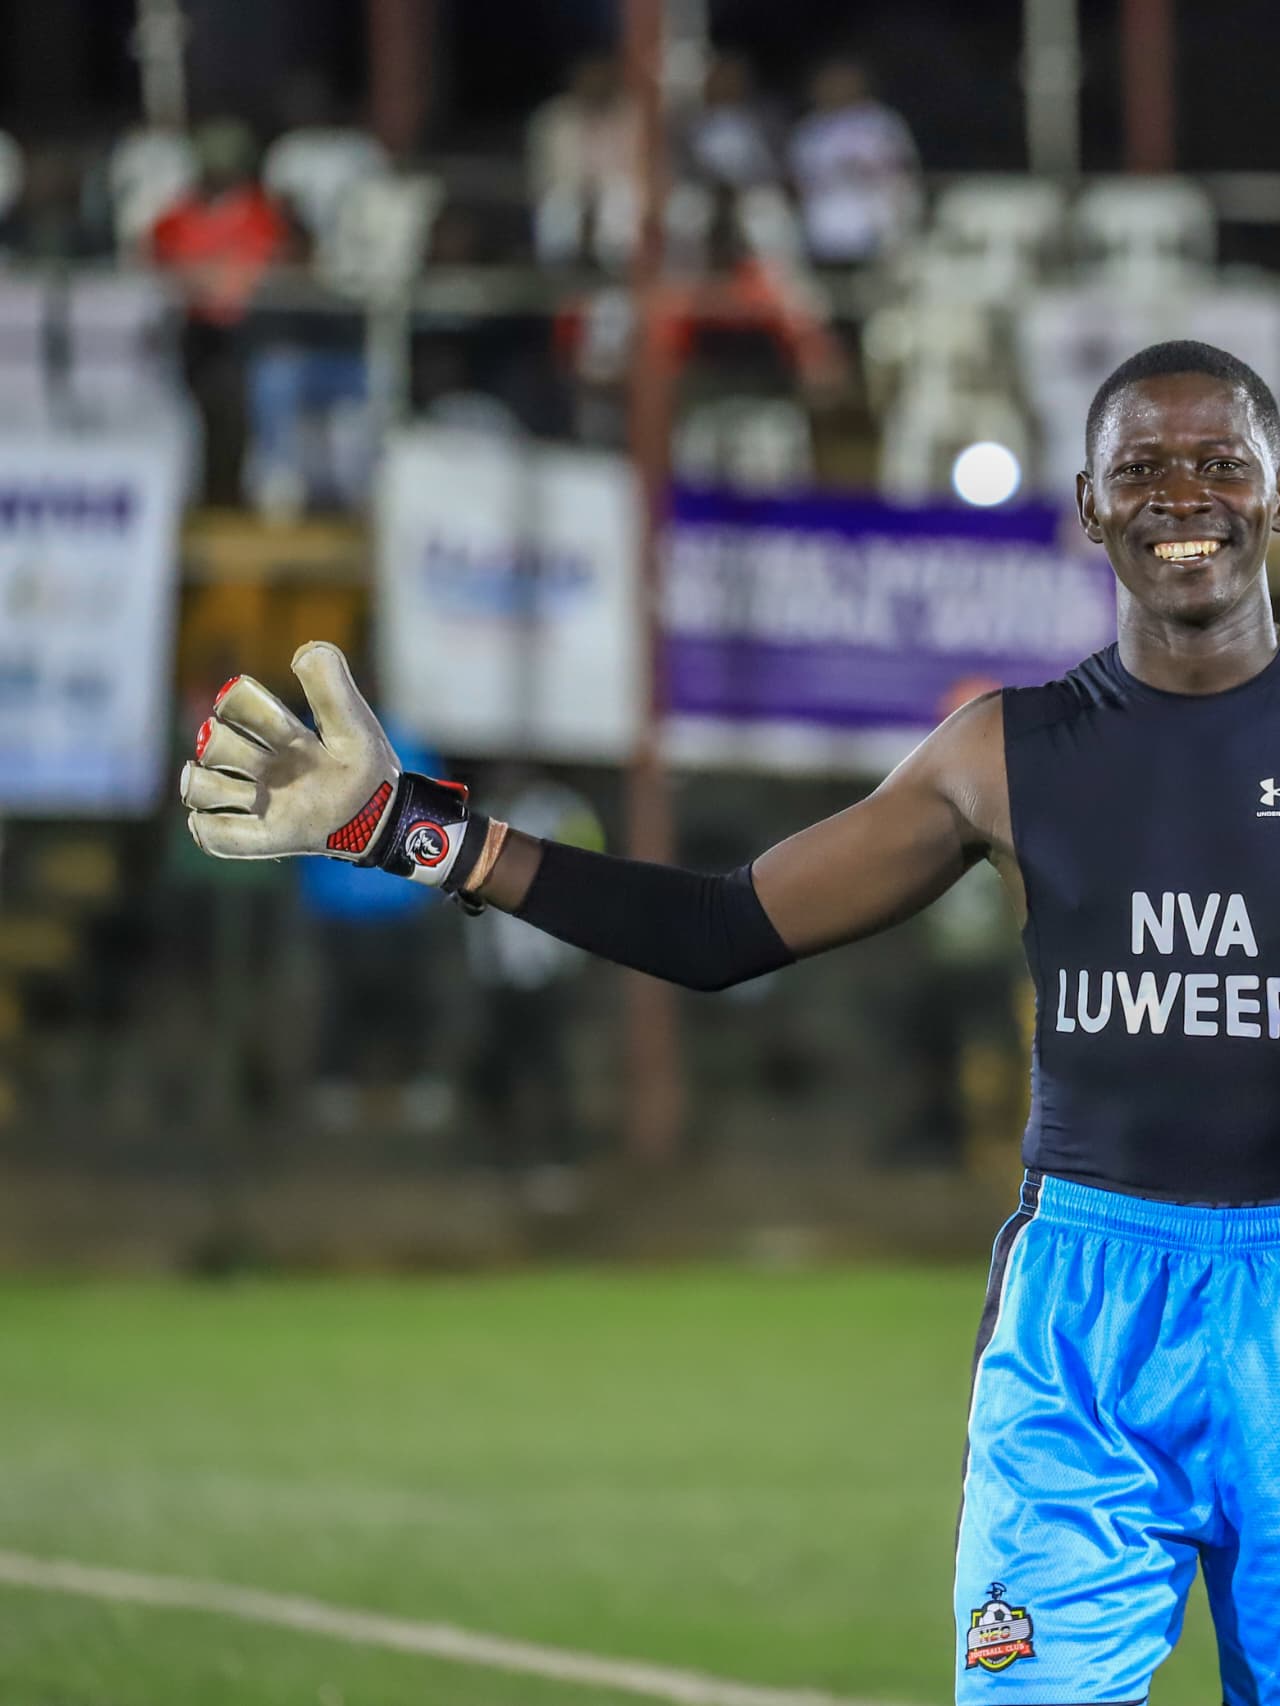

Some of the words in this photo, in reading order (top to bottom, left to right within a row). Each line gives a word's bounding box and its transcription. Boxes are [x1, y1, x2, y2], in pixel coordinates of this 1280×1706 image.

[1256, 810, 1280, 818] UNDER
[1131, 891, 1259, 957] NVA
[1006, 1642, 1025, 1652] CLUB
